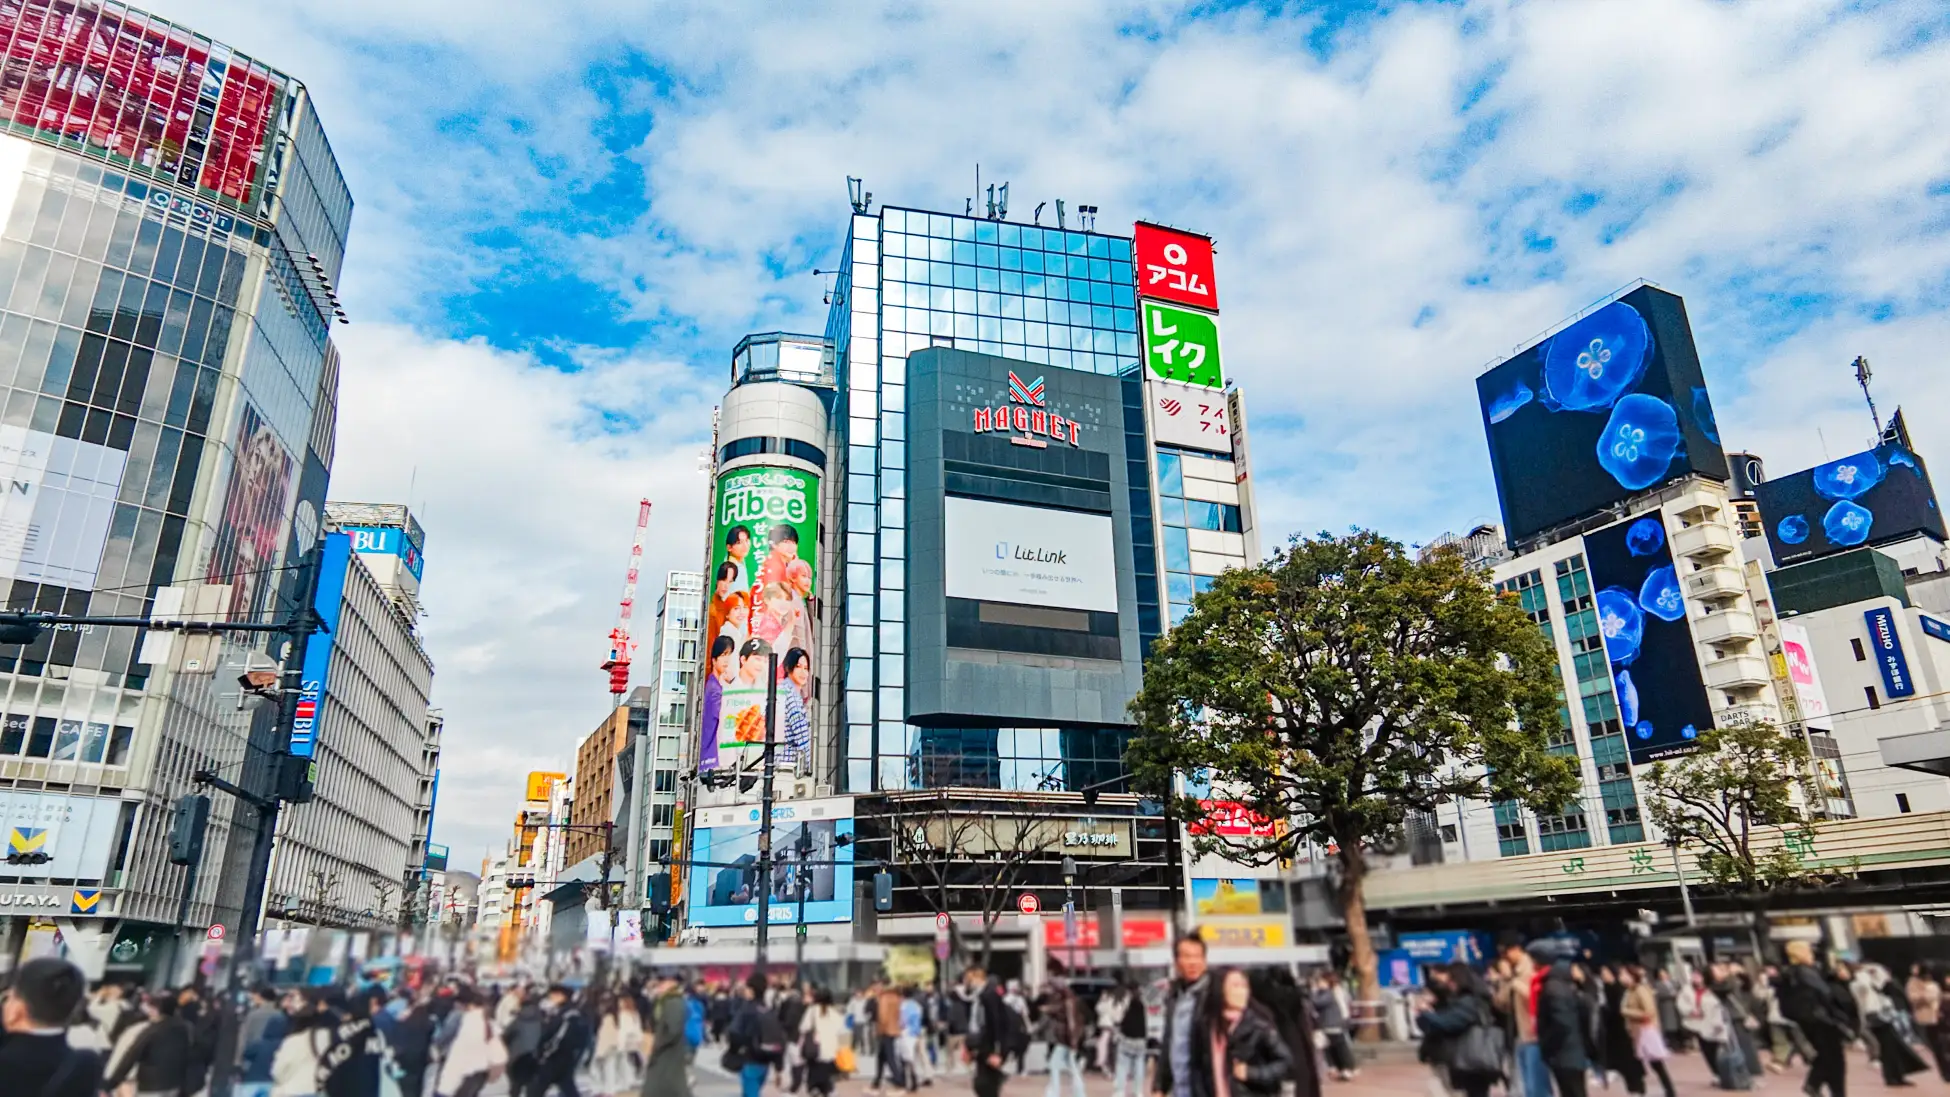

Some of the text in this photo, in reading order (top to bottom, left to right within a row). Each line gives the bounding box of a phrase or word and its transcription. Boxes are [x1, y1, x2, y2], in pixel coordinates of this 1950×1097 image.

[1146, 264, 1208, 295] アコム
[1152, 310, 1177, 336] レ
[1152, 339, 1206, 369] イク
[1198, 404, 1224, 419] アイ
[974, 405, 1081, 448] MAGNET
[1199, 421, 1227, 435] フル
[723, 489, 805, 524] Fibee
[1876, 614, 1893, 650] MIZUHO
[1720, 711, 1750, 722] DARTS
[60, 722, 104, 738] CAFE
[1064, 831, 1119, 847] 星乃珈琲
[1562, 857, 1585, 873] JR
[0, 893, 61, 907] UTAYA
